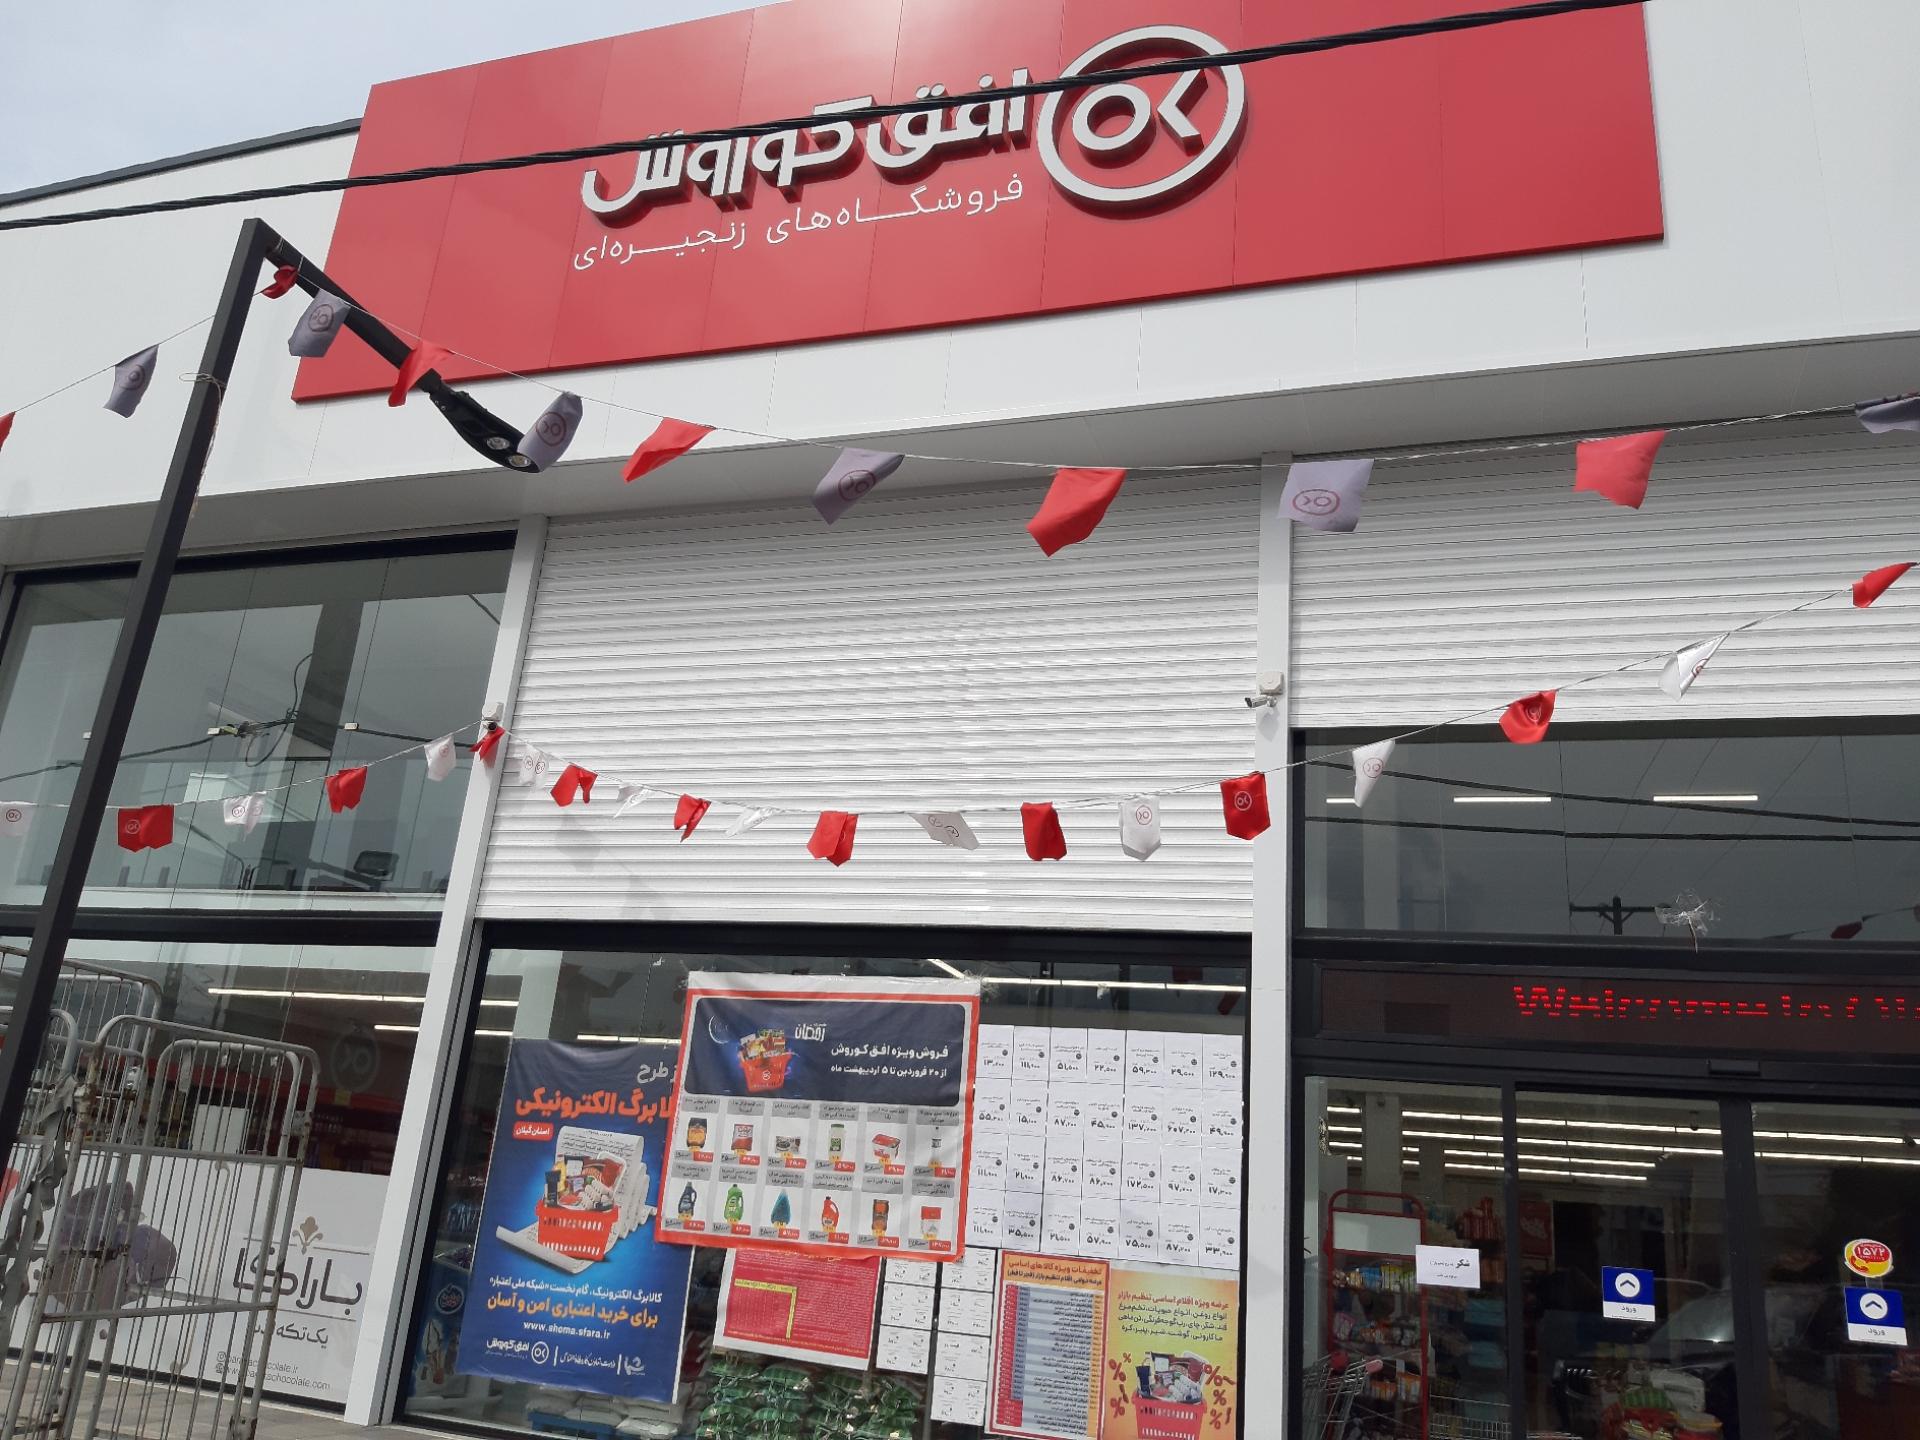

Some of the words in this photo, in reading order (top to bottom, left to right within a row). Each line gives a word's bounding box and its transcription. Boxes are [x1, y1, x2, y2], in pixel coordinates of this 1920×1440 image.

[866, 67, 1028, 168] افق
[581, 94, 873, 213] کوروش
[831, 1042, 869, 1056] کوروش
[869, 1043, 890, 1057] افق
[892, 1046, 915, 1058] ویژه
[915, 1045, 949, 1060] فروش
[637, 1060, 668, 1084] طرح
[831, 1064, 842, 1072] ماه
[843, 1065, 880, 1076] اردیبهشت
[889, 1065, 897, 1073] تا
[896, 1065, 927, 1078] فروردین
[929, 1067, 940, 1076] ۲۰
[940, 1068, 947, 1078] از
[515, 1086, 617, 1118] الکترونیکی
[515, 1126, 533, 1136] گیلان
[533, 1127, 550, 1136] استان
[1857, 1246, 1885, 1257] ۱۵۷۲
[1008, 1259, 1029, 1269] اساسی
[1054, 1264, 1070, 1273] ویژه
[1072, 1265, 1102, 1275] تخفیفات
[512, 1278, 526, 1289] ملی
[551, 1283, 575, 1293] نخست
[575, 1284, 589, 1297] گام
[632, 1288, 662, 1303] کالابرگ
[1118, 1291, 1131, 1299] بازار
[487, 1291, 518, 1311] آسان
[1132, 1292, 1151, 1301] تنظیم
[1152, 1295, 1176, 1304] اساسی
[1176, 1296, 1194, 1306] اقلام
[518, 1302, 526, 1313] و
[526, 1296, 550, 1314] امن
[1195, 1299, 1210, 1309] ویژه
[1211, 1301, 1229, 1309] عرضه
[1621, 1305, 1637, 1313] ورود
[551, 1302, 595, 1318] اعتباری
[598, 1306, 629, 1324] خرید
[1173, 1308, 1190, 1316] انواع
[1212, 1310, 1227, 1320] انواع
[630, 1310, 659, 1328] برای
[276, 1323, 307, 1340] تکه
[1121, 1324, 1133, 1332] کره
[1867, 1327, 1886, 1336] ورود
[306, 1328, 329, 1349] یک
[513, 1341, 530, 1352] افق
